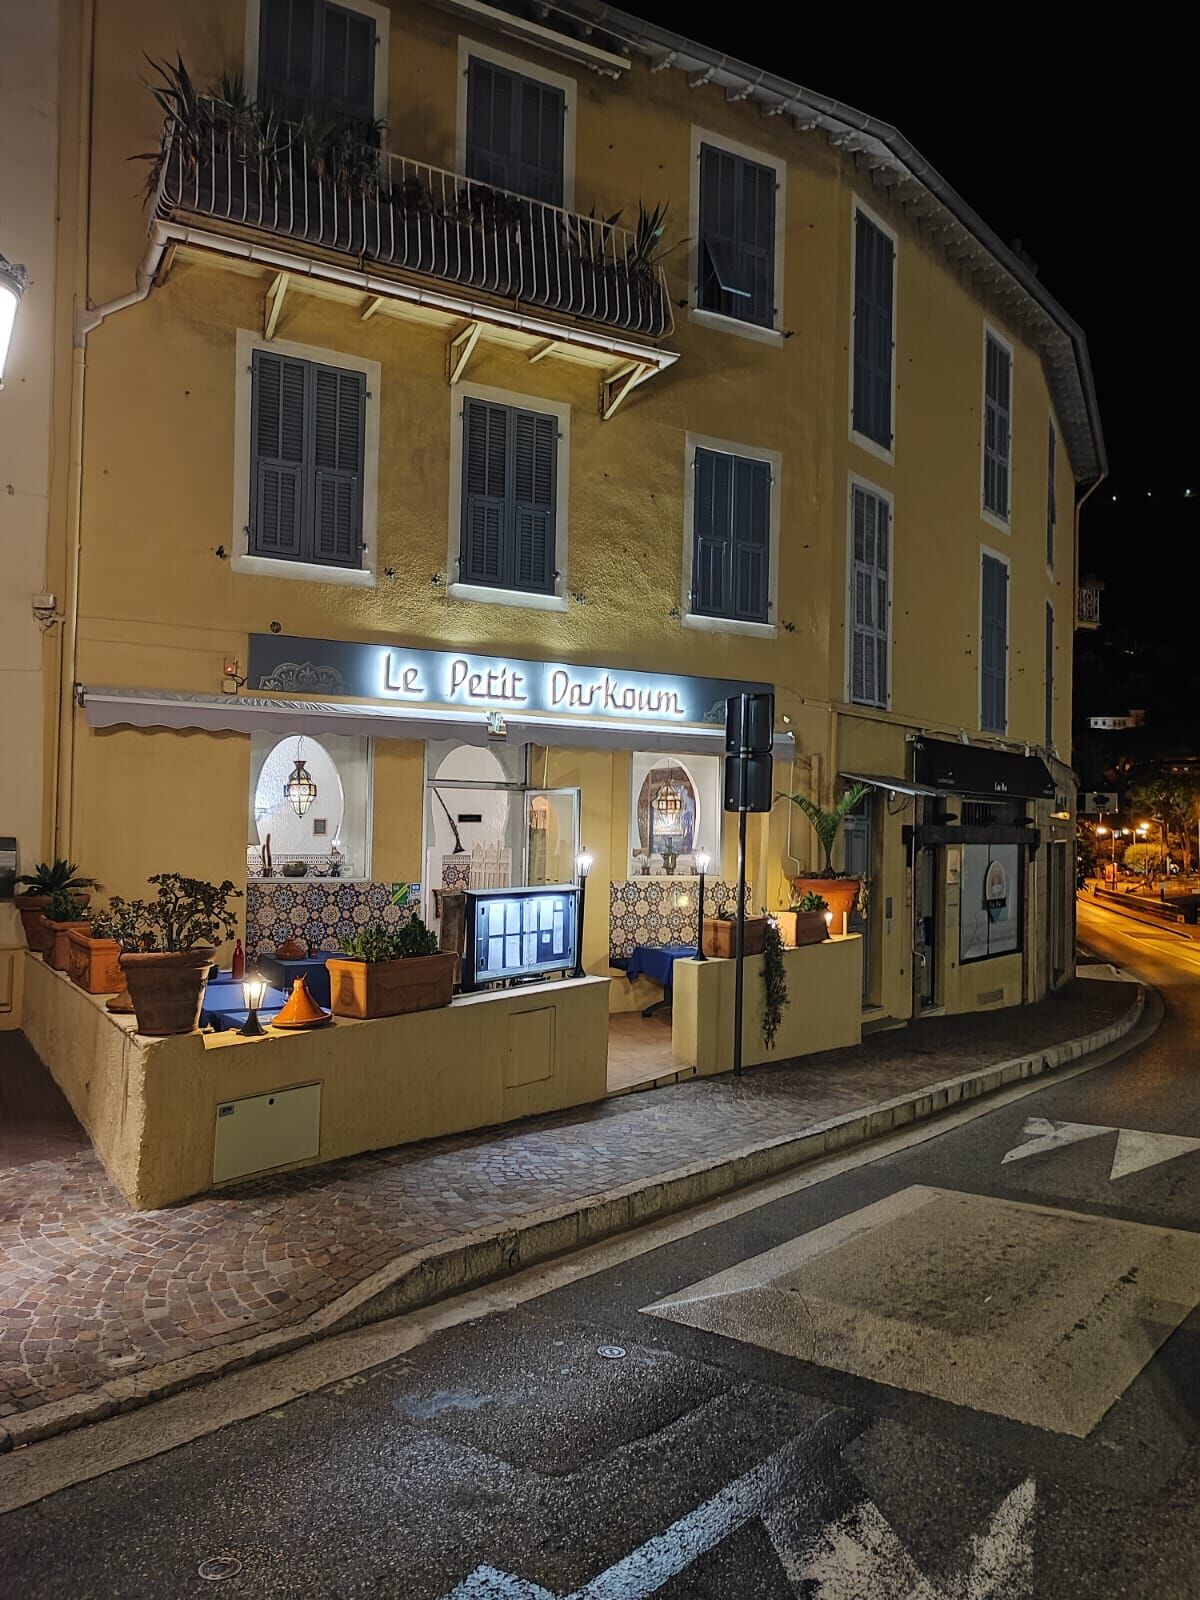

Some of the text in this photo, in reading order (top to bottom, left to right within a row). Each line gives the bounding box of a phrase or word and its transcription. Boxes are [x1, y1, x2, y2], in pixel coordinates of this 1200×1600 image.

[384, 652, 685, 714] Le Petit Darkoum
